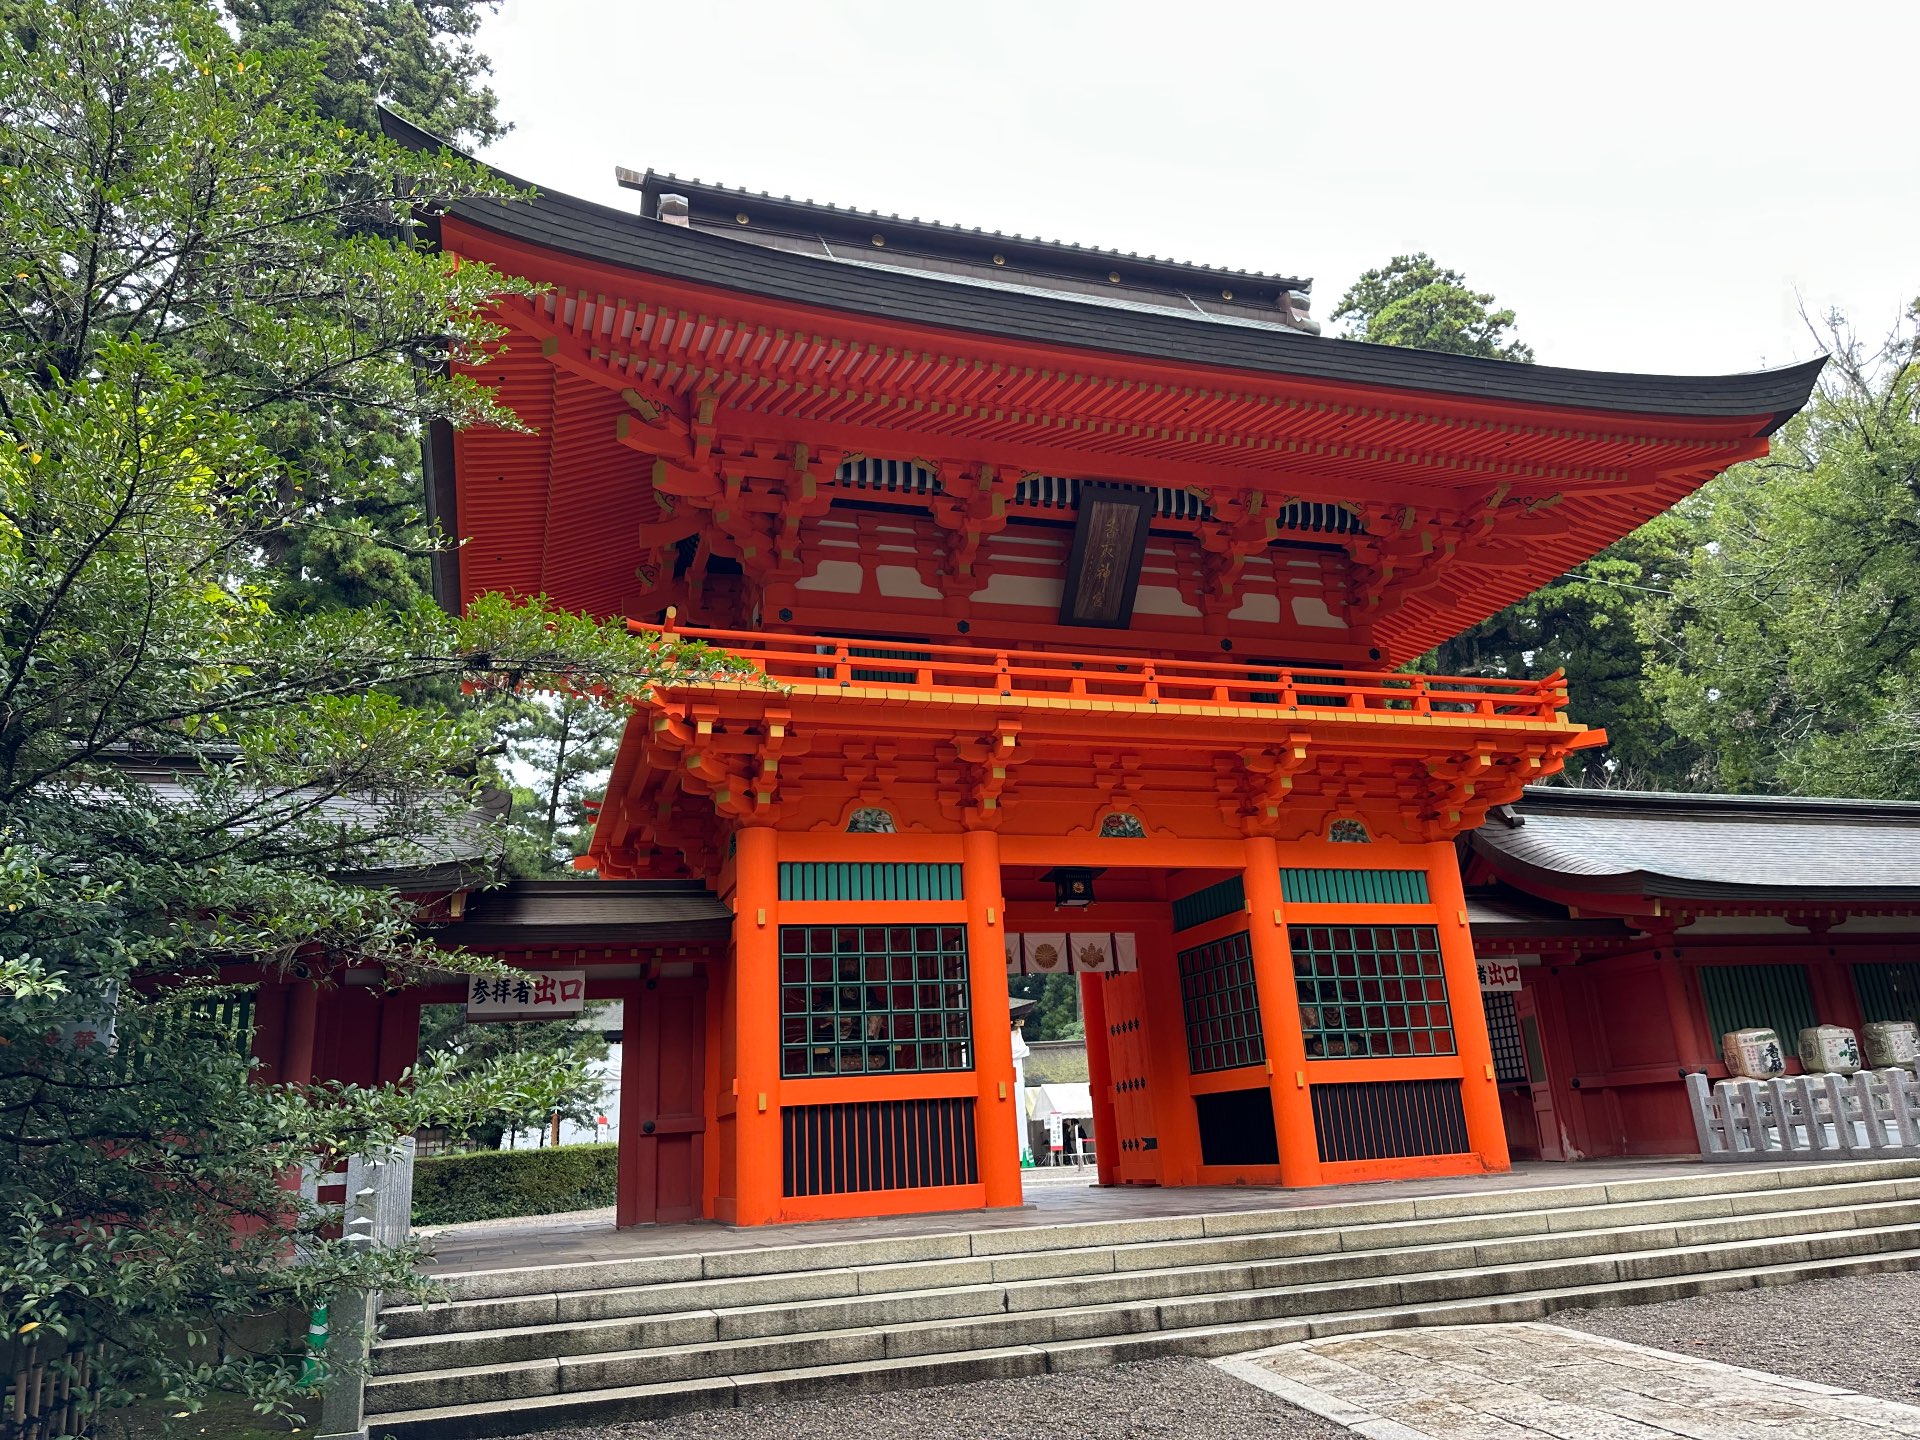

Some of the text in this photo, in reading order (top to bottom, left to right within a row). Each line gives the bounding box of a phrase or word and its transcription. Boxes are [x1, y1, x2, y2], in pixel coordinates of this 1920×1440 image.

[1092, 514, 1120, 608] 香取神宮
[471, 974, 584, 1006] 参拝者出口
